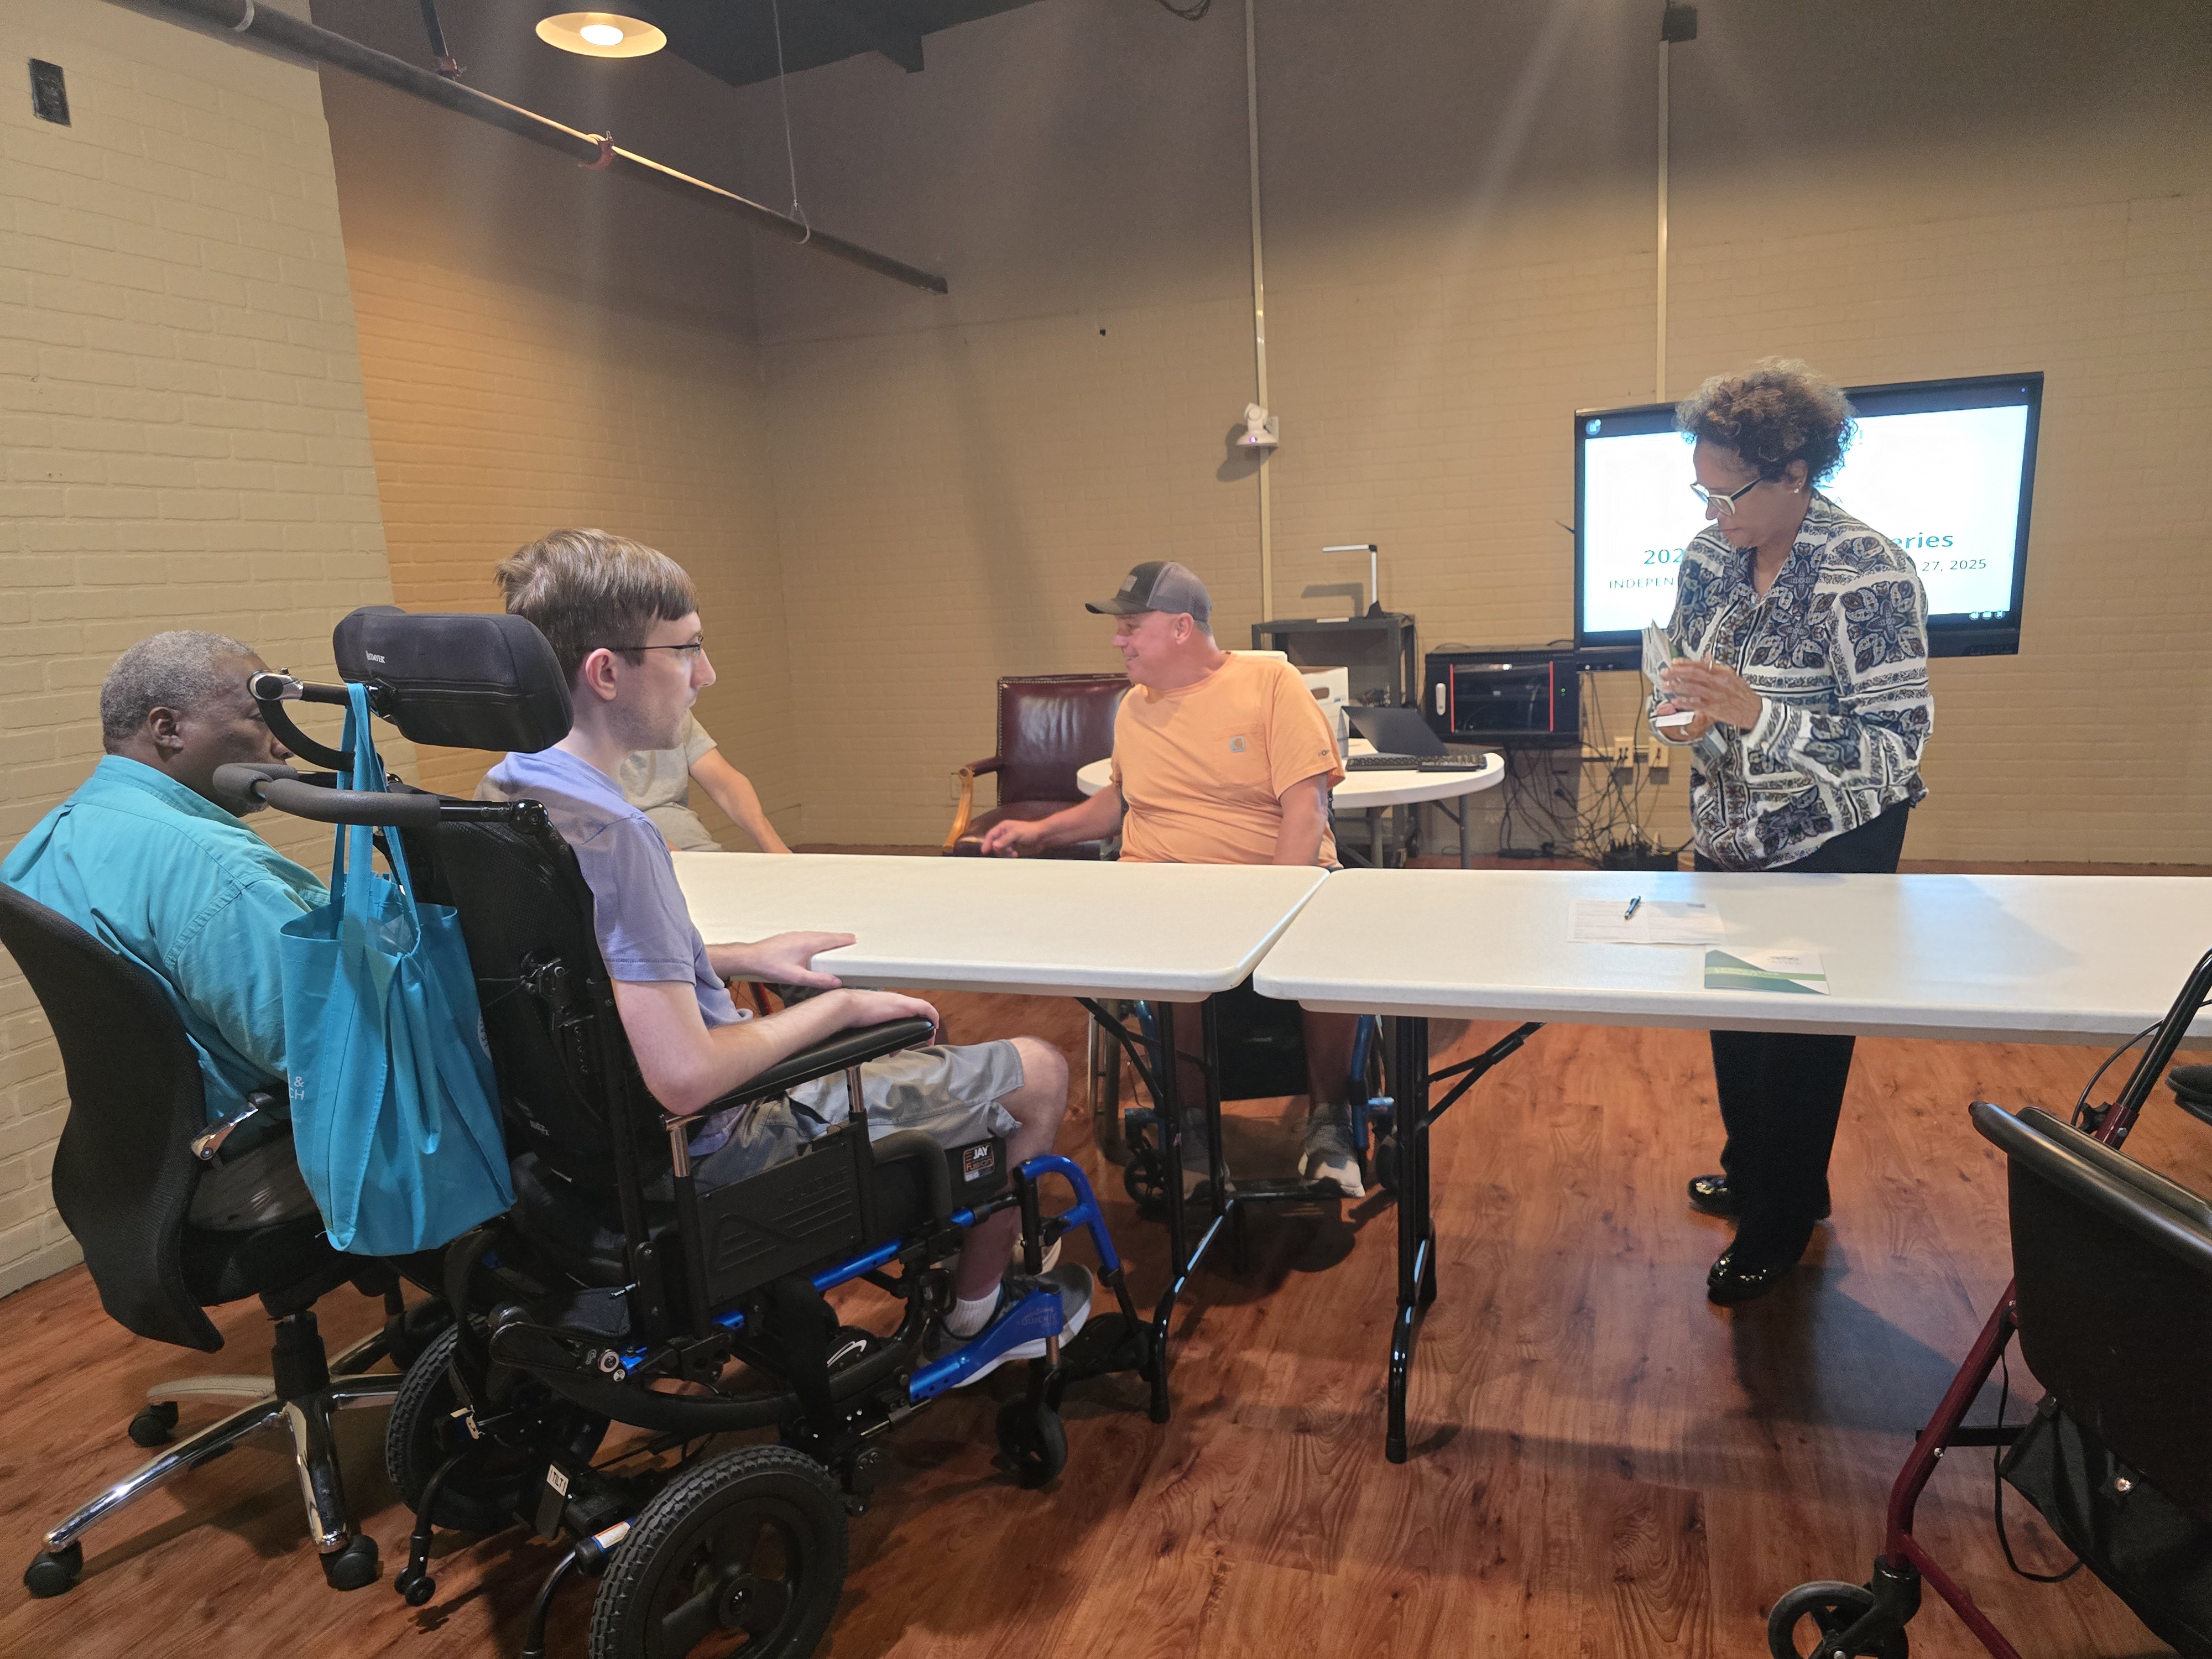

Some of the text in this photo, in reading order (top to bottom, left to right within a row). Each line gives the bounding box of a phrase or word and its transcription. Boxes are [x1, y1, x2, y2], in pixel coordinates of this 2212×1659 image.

[1922, 561, 1943, 572] 27,
[1950, 559, 1986, 570] 2025
[294, 1076, 305, 1088] &
[973, 1145, 989, 1160] JAY
[552, 1471, 564, 1488] TILT
